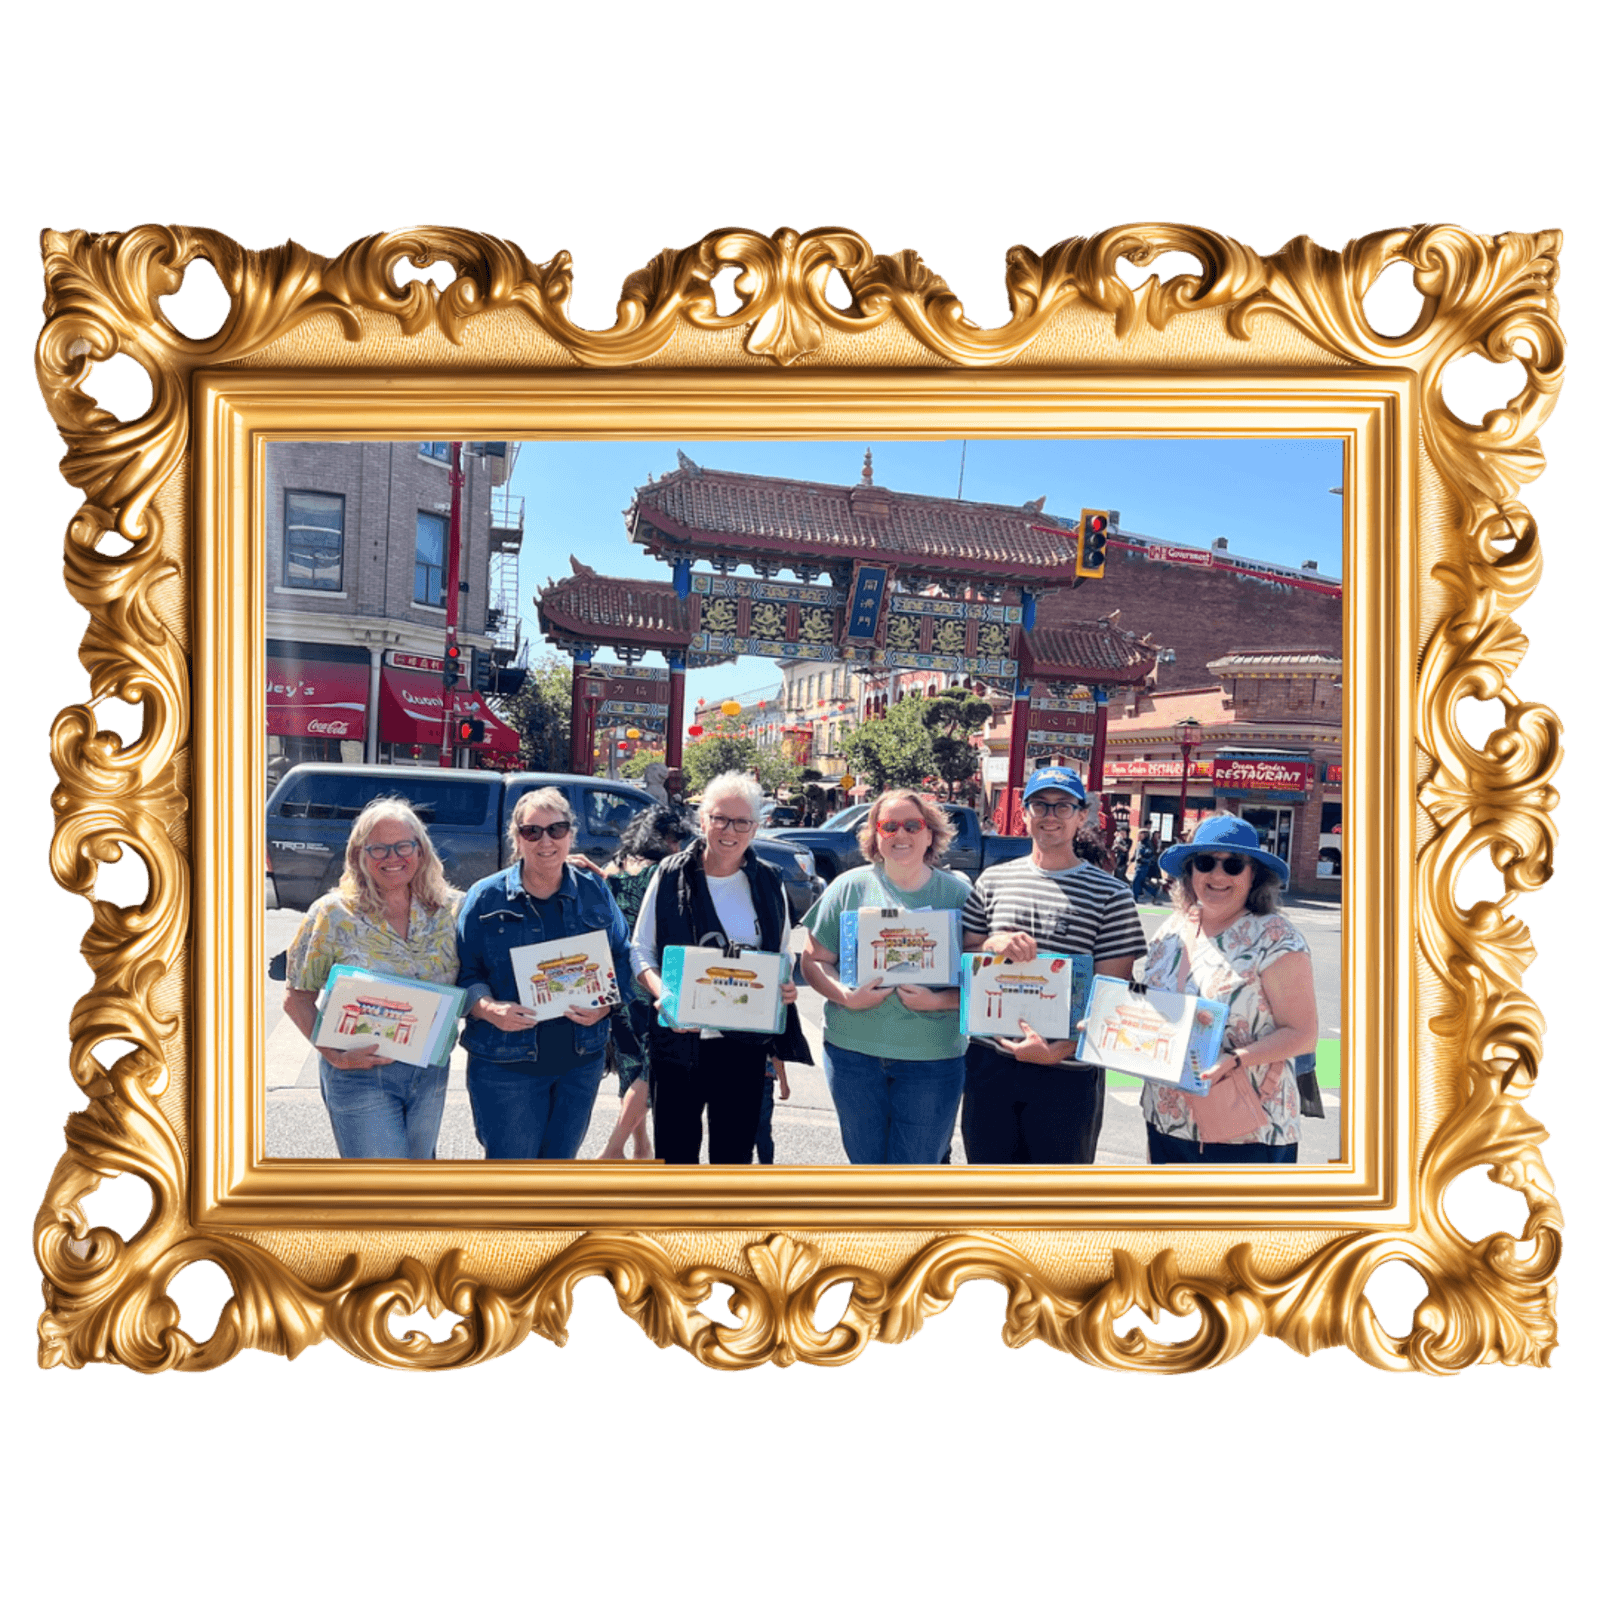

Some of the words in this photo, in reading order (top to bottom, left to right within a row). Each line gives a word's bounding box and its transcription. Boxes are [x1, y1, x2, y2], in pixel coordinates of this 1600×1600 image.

[1148, 762, 1197, 776] RESTAURNT
[1256, 762, 1287, 772] Garden
[1215, 768, 1302, 783] RESTAURANT
